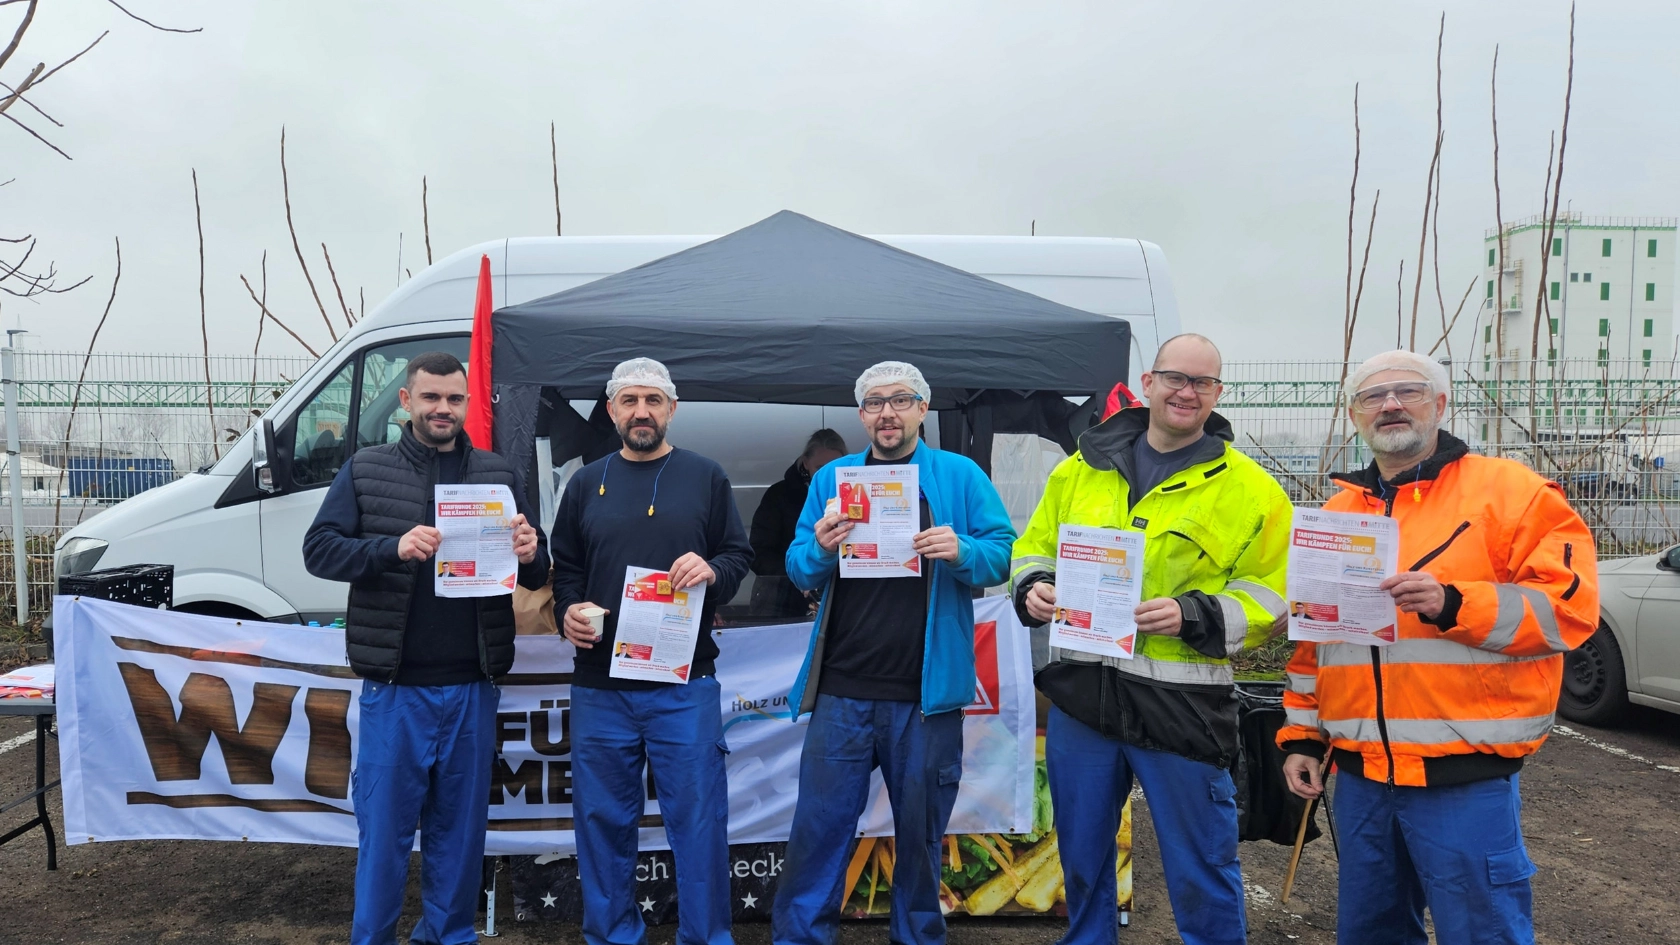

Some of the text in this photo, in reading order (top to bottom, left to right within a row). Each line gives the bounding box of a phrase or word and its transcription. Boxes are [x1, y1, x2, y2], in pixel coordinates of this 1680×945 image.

[1302, 514, 1361, 527] TARIFNACHRICHTEN
[1296, 531, 1353, 544] TARIFRUNDE 2025:
[1062, 545, 1109, 556] TARIFRUNDE 2025:
[1296, 538, 1372, 553] WIR KÄMPFEN FÜR EUCH!
[1073, 551, 1097, 561] KÄMPFEN
[732, 698, 769, 712] HOLZ
